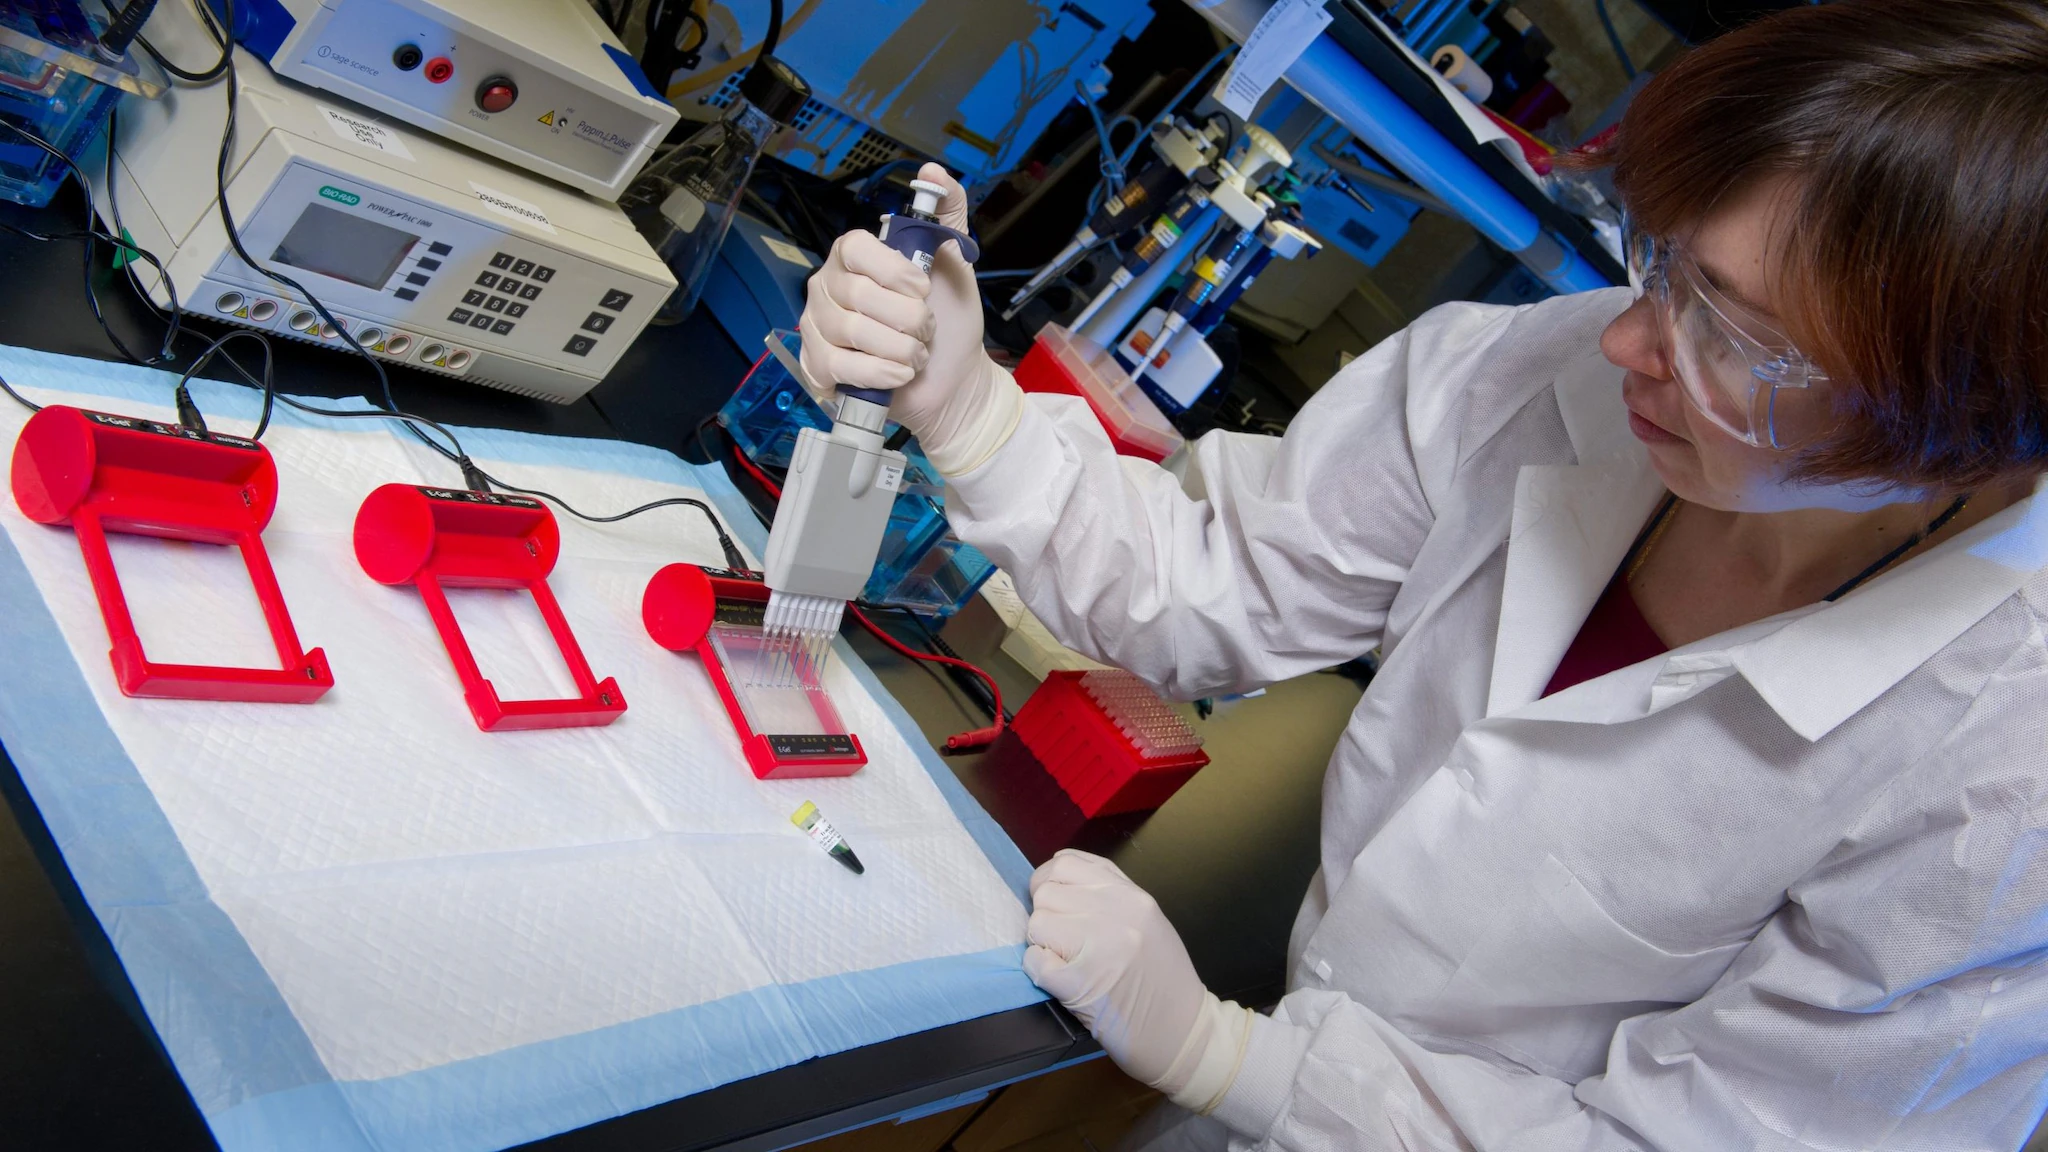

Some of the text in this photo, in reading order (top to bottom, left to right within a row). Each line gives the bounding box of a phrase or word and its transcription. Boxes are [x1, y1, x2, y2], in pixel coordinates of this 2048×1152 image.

[331, 51, 379, 77] sage science
[329, 111, 387, 137] Research
[469, 108, 490, 122] POWER
[349, 124, 374, 139] Use
[577, 120, 604, 138] Pippin
[609, 134, 632, 150] Pulse
[355, 133, 384, 150] Only
[322, 188, 358, 204] BIO-RAD
[367, 202, 396, 217] POWER
[499, 257, 548, 279] 1 2 3
[484, 275, 534, 297] 4 5 6
[471, 293, 521, 315] 7 8 9
[453, 311, 469, 321] EXIT
[477, 318, 486, 327] 0
